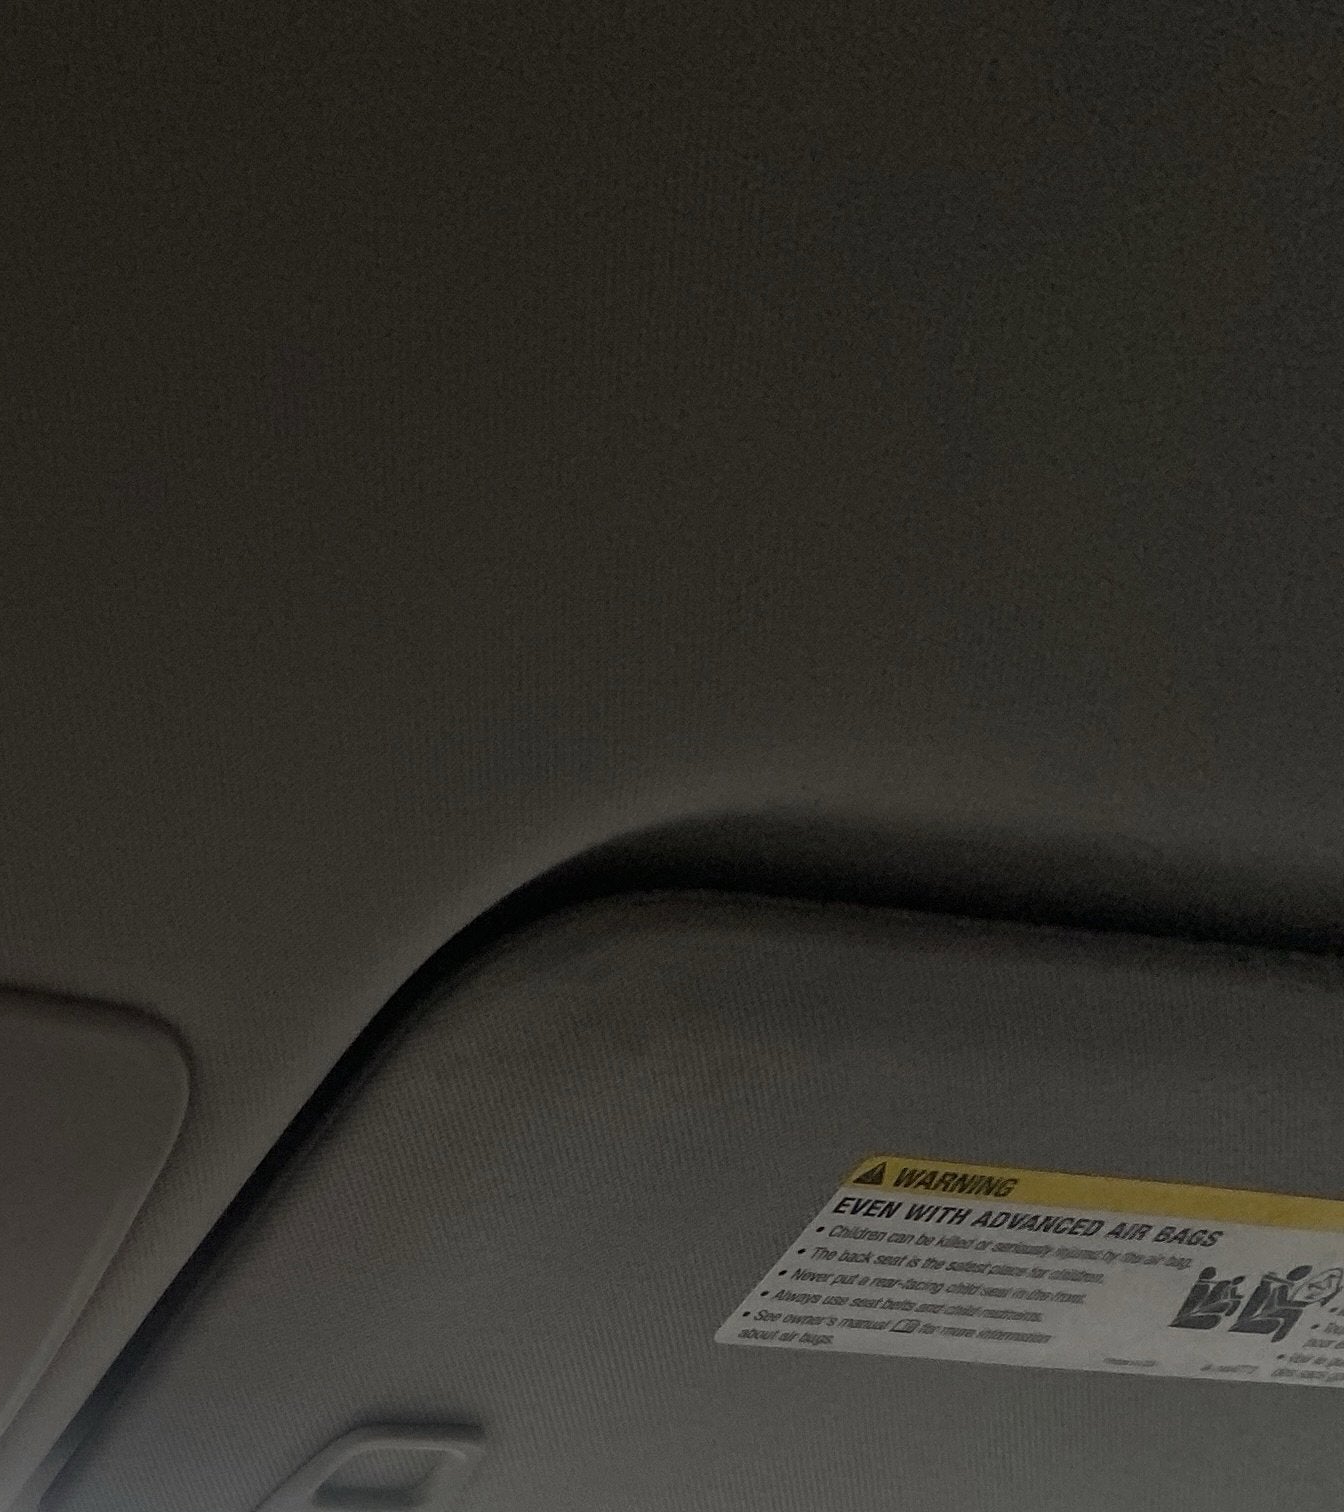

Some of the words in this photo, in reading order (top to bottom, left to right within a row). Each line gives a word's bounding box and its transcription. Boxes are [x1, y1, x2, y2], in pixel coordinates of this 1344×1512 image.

[893, 1167, 1019, 1198] WARNING
[833, 1197, 902, 1218] EVEN
[904, 1203, 973, 1225] WITH
[971, 1210, 1105, 1238] ADVANCED
[1105, 1221, 1153, 1242] AIR
[1152, 1225, 1224, 1248] BAGS
[828, 1224, 887, 1242] Children
[887, 1231, 914, 1245] can
[915, 1233, 935, 1247] be
[811, 1247, 838, 1261] The
[838, 1249, 874, 1264] back
[873, 1254, 908, 1267] seat
[906, 1255, 921, 1268] is
[921, 1257, 945, 1270] the
[791, 1268, 834, 1283] Never
[829, 1272, 860, 1286] put
[858, 1276, 871, 1286] a
[772, 1290, 822, 1305] Always
[822, 1295, 849, 1306] use
[849, 1298, 883, 1309] seat
[753, 1310, 782, 1322] See
[782, 1314, 838, 1327] owner's
[838, 1318, 892, 1331] manual
[738, 1330, 779, 1341] about
[778, 1331, 800, 1342] air
